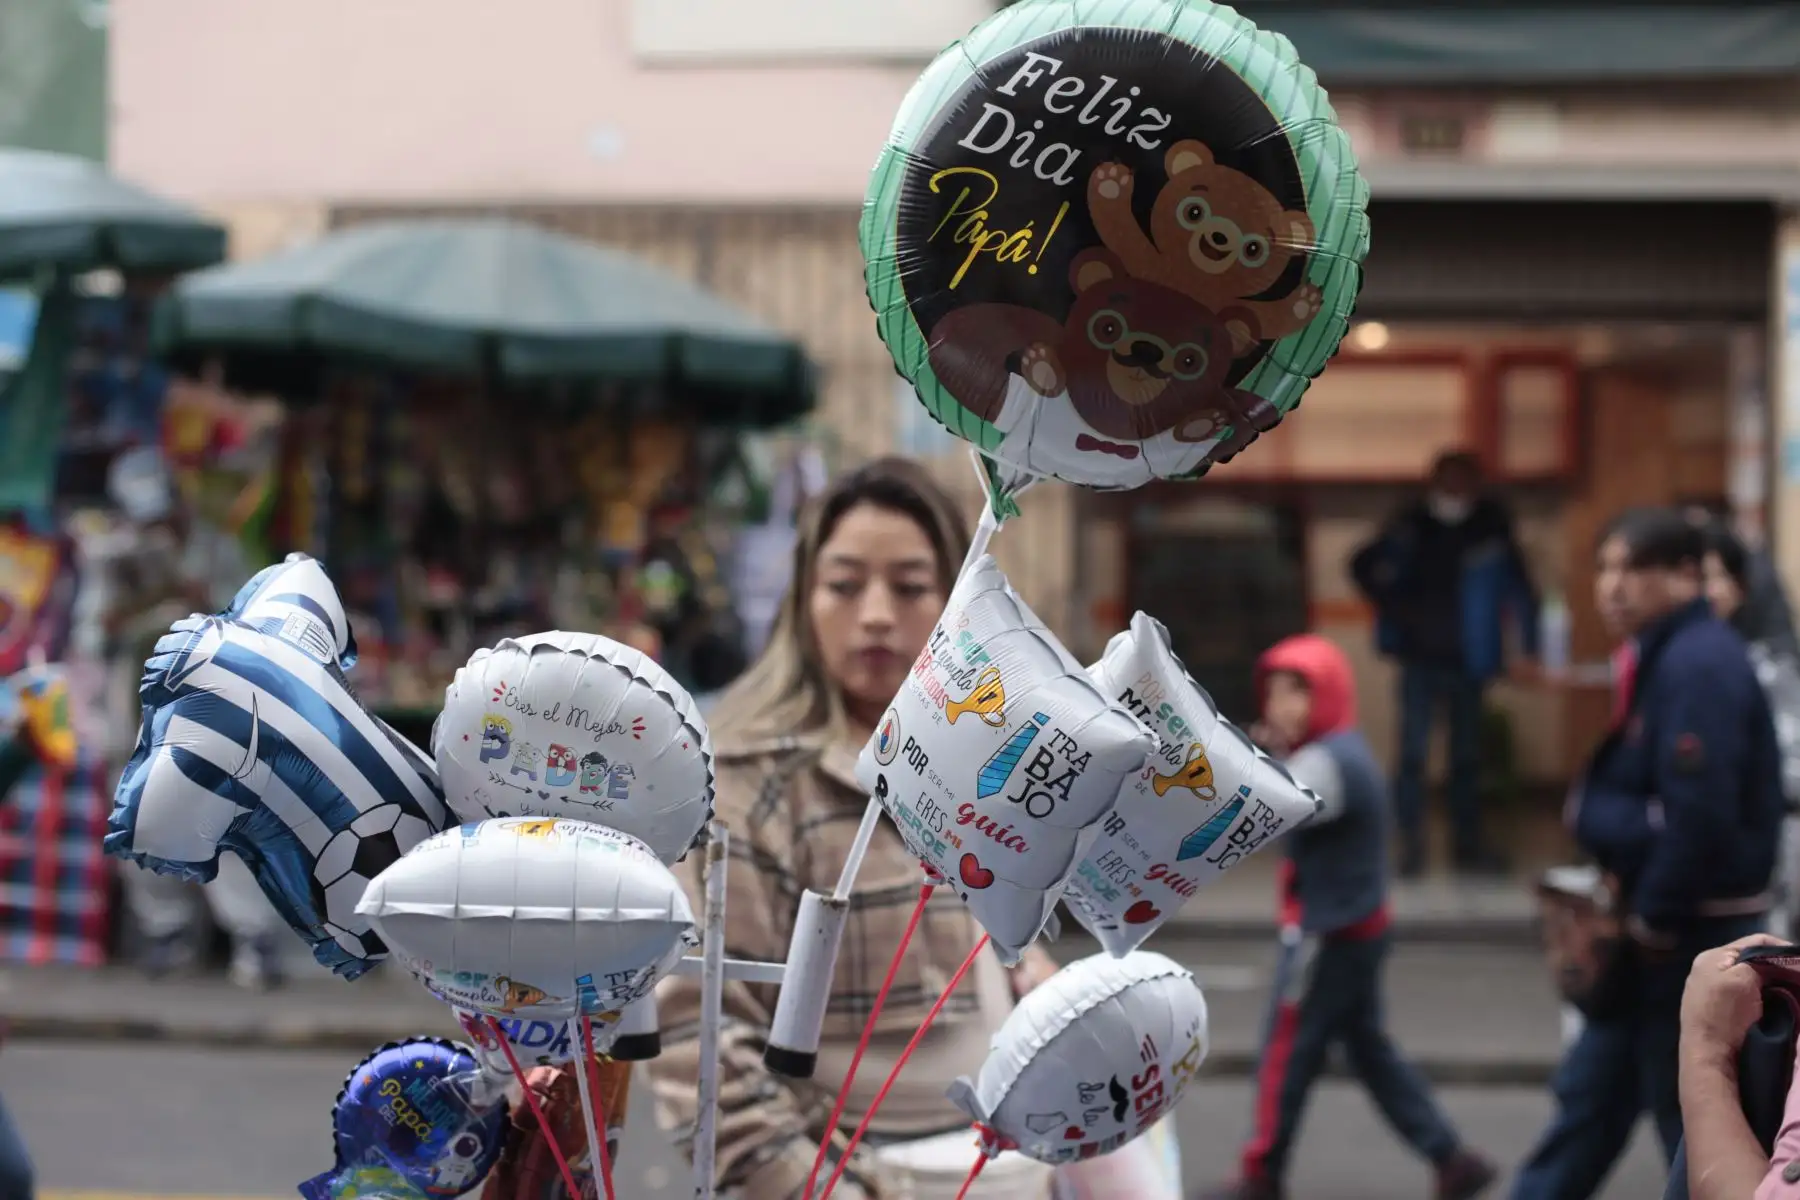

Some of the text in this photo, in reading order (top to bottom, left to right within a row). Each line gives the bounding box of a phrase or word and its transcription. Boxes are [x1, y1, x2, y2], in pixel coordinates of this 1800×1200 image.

[997, 52, 1172, 150] Feliz
[958, 103, 1082, 186] Dia
[927, 166, 1070, 291] Papá!
[504, 686, 627, 742] Eres el Mejor
[1118, 688, 1151, 719] MI
[479, 713, 636, 800] PADRE
[901, 735, 956, 800] POR SER MI
[1024, 746, 1080, 801] BA
[1048, 728, 1093, 773] TRA
[915, 792, 948, 833] ERES
[944, 830, 962, 850] MI
[1007, 778, 1055, 818] JO
[1251, 799, 1284, 834] TRA
[893, 793, 947, 858] HEROE
[956, 803, 1031, 853] guía
[1121, 833, 1139, 850] SER
[1228, 816, 1269, 855] BA
[1095, 849, 1137, 885] ERES
[379, 1103, 397, 1127] DEL
[1077, 1082, 1110, 1128] de la
